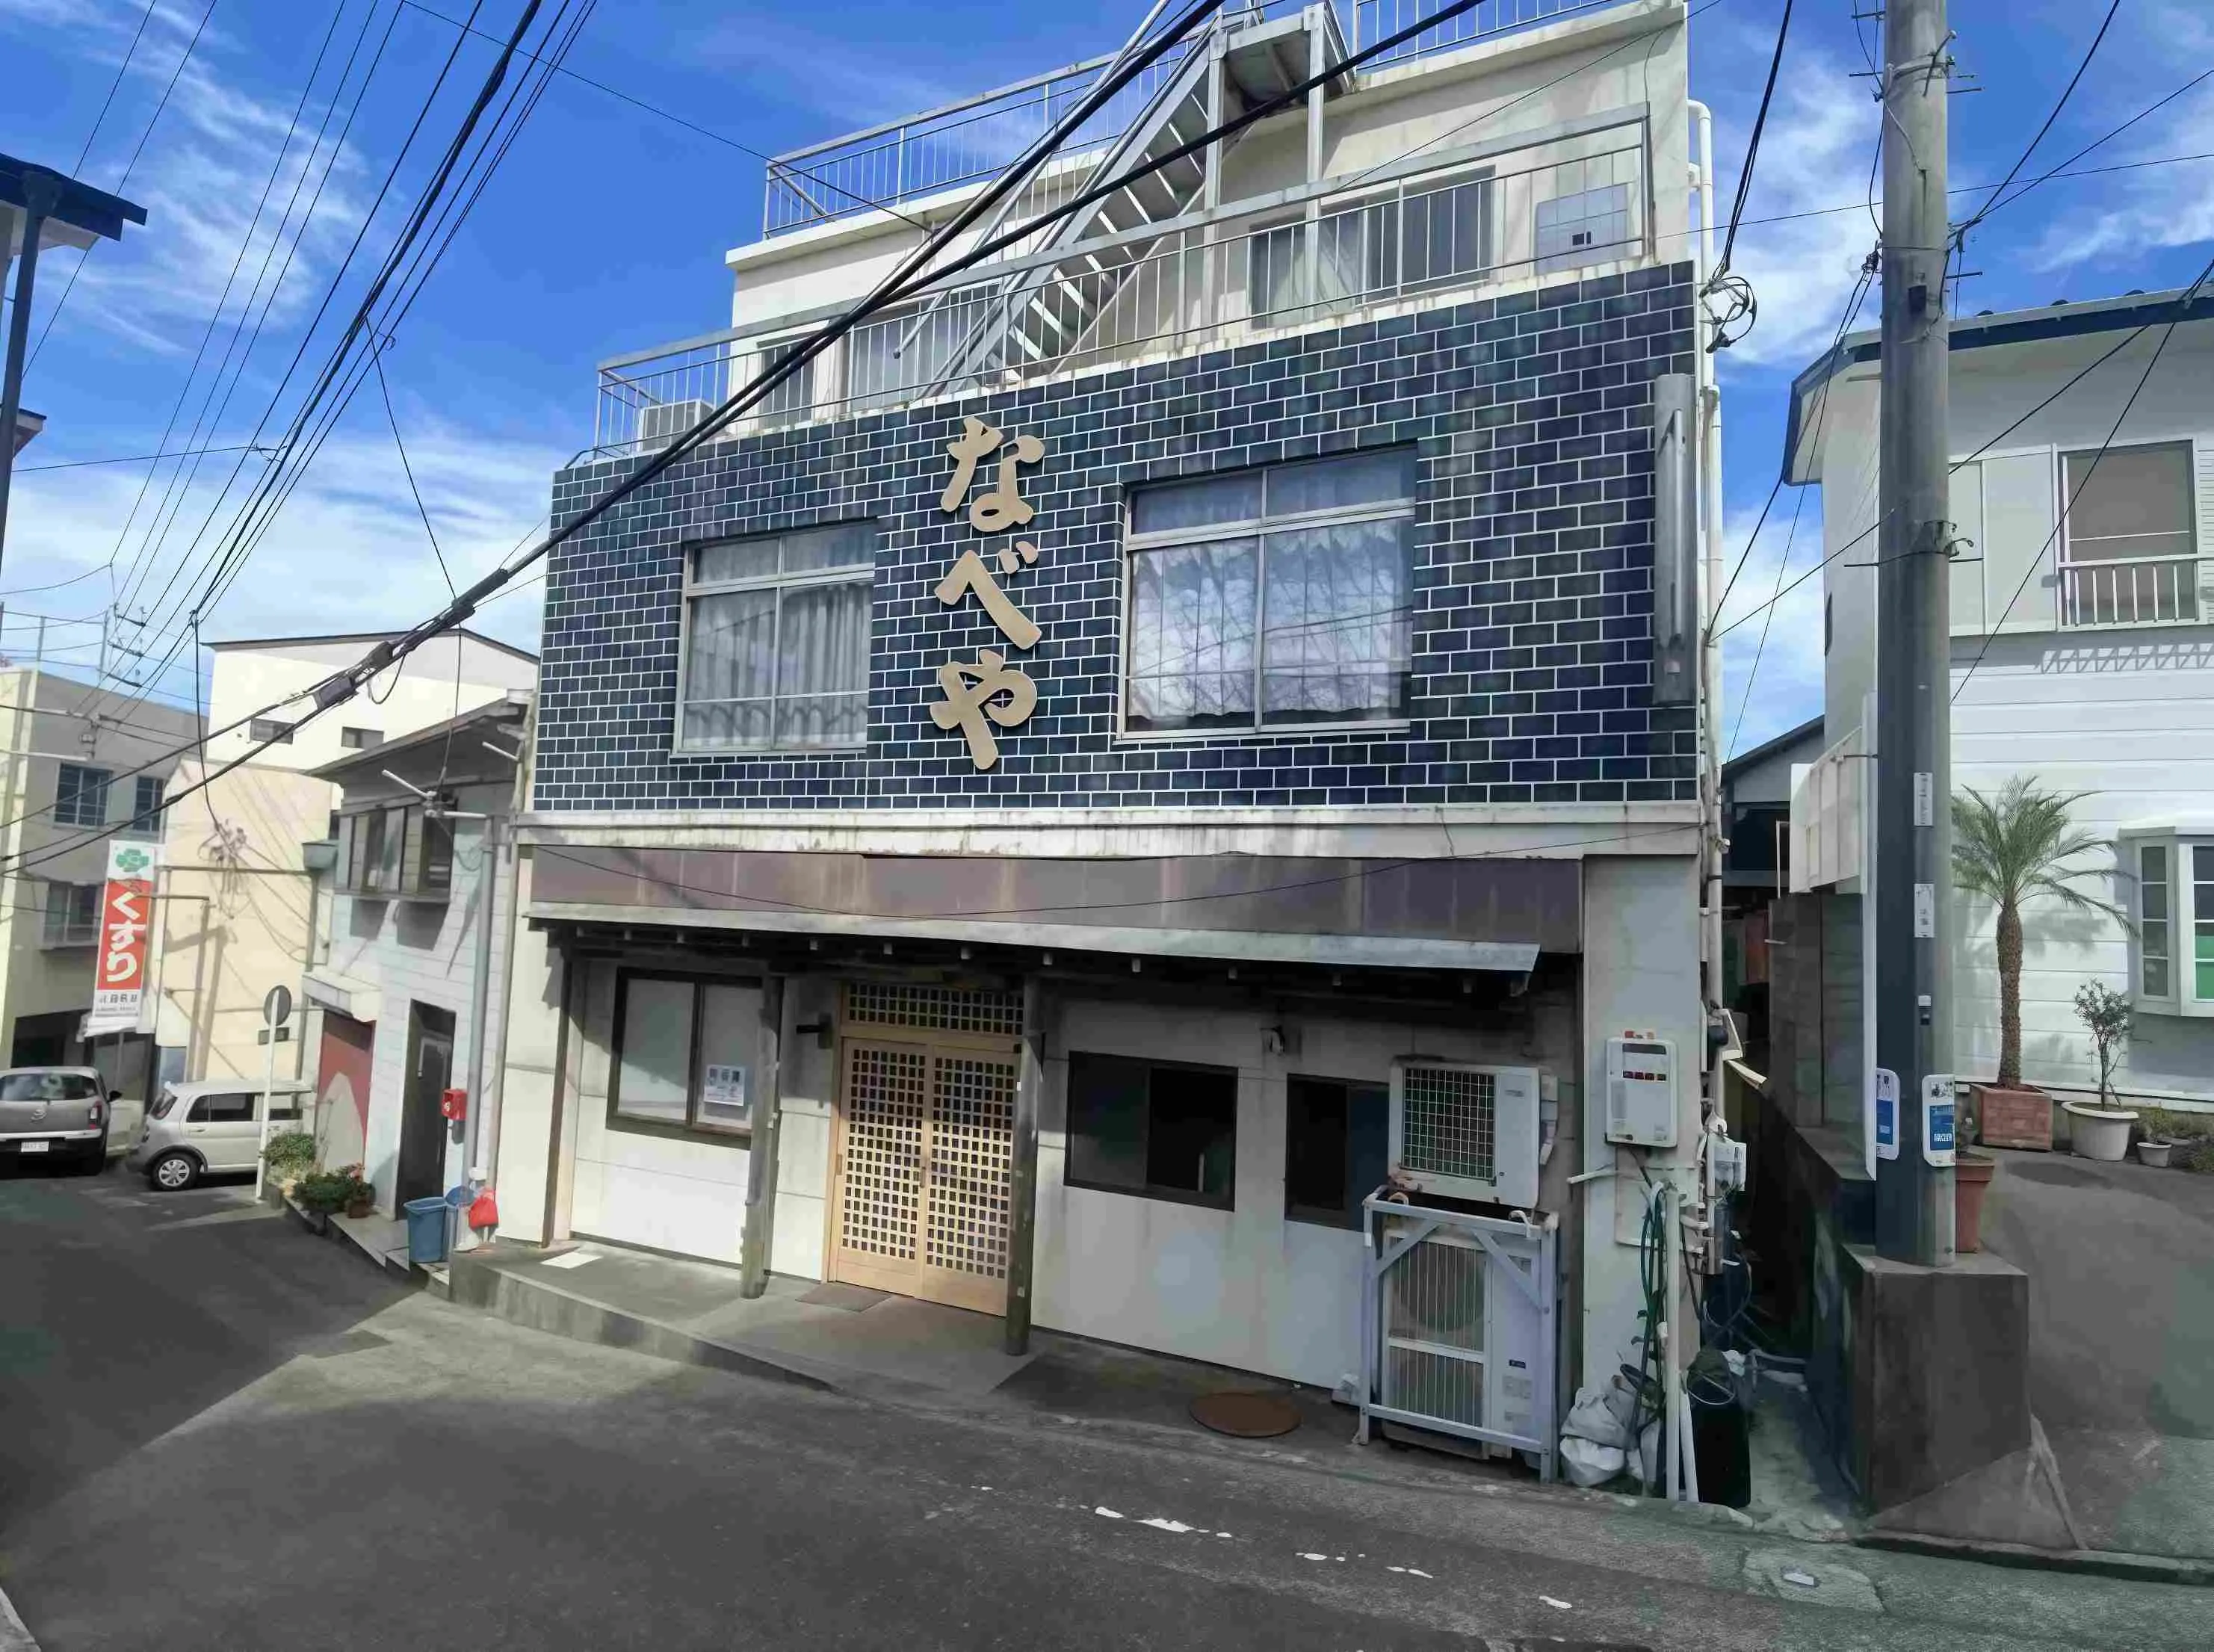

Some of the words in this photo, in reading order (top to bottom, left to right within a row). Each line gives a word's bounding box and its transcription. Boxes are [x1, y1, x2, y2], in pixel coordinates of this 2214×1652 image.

[930, 415, 1046, 770] なべや
[106, 891, 146, 983] くすり
